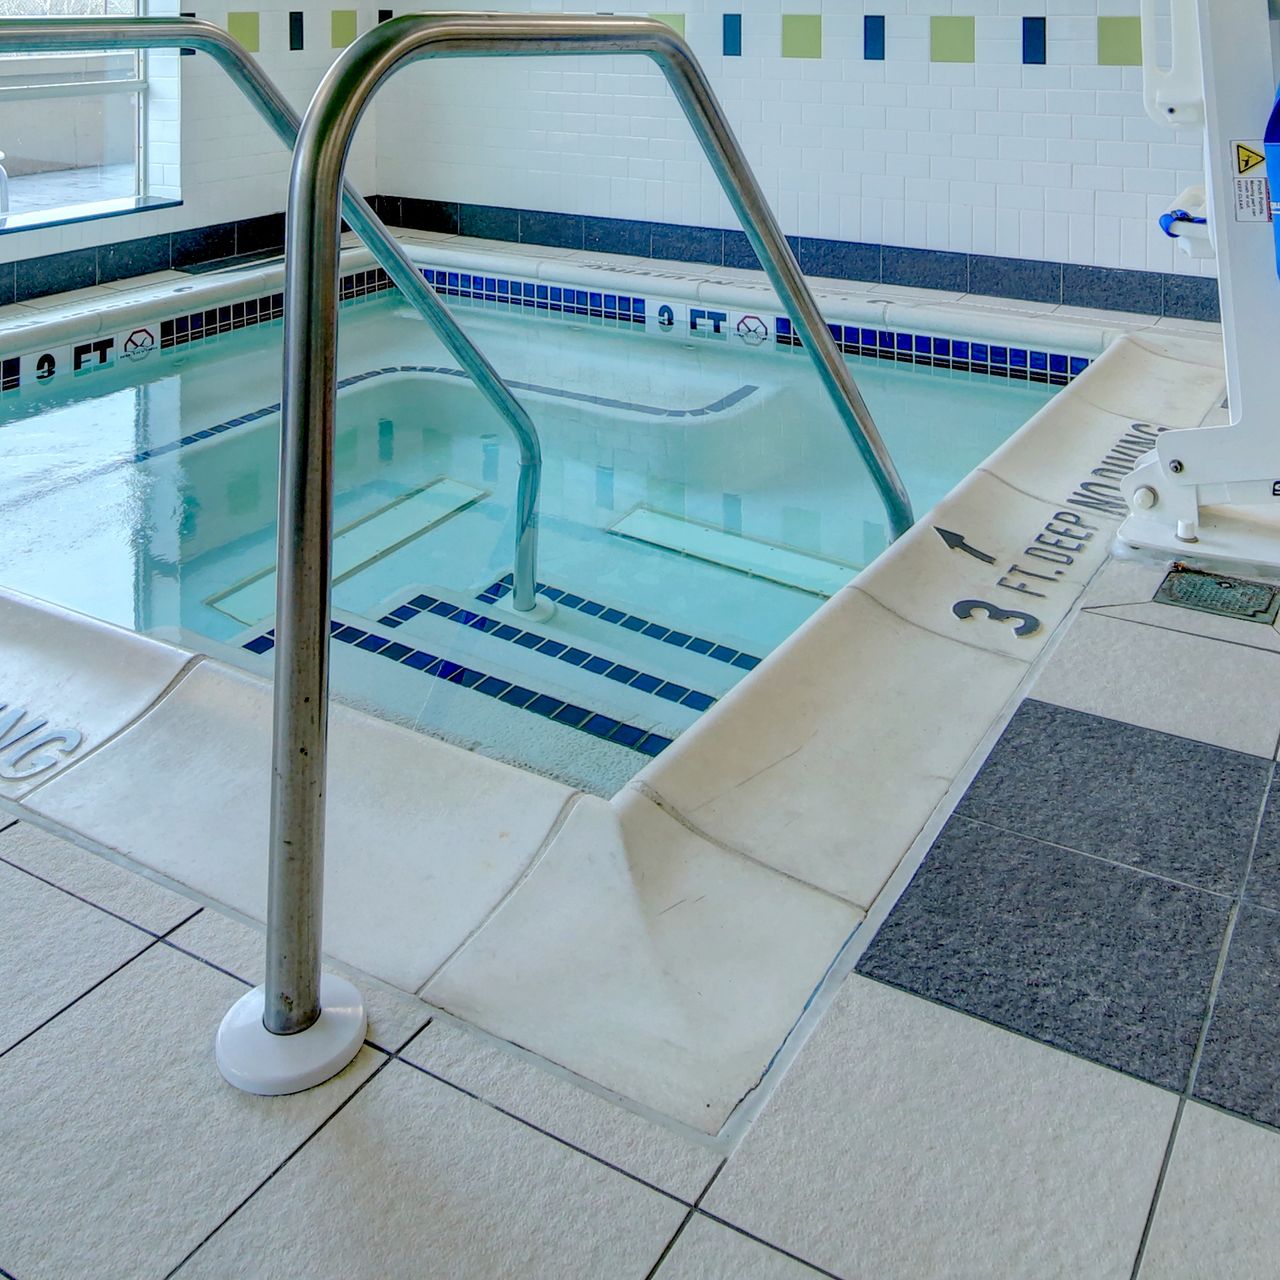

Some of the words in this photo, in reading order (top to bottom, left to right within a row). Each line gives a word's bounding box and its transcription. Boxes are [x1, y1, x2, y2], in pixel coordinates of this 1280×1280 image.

[690, 308, 727, 334] FT
[73, 337, 115, 371] FT
[1024, 511, 1100, 566] DEEP
[996, 563, 1065, 599] FT.
[952, 598, 1041, 637] 3
